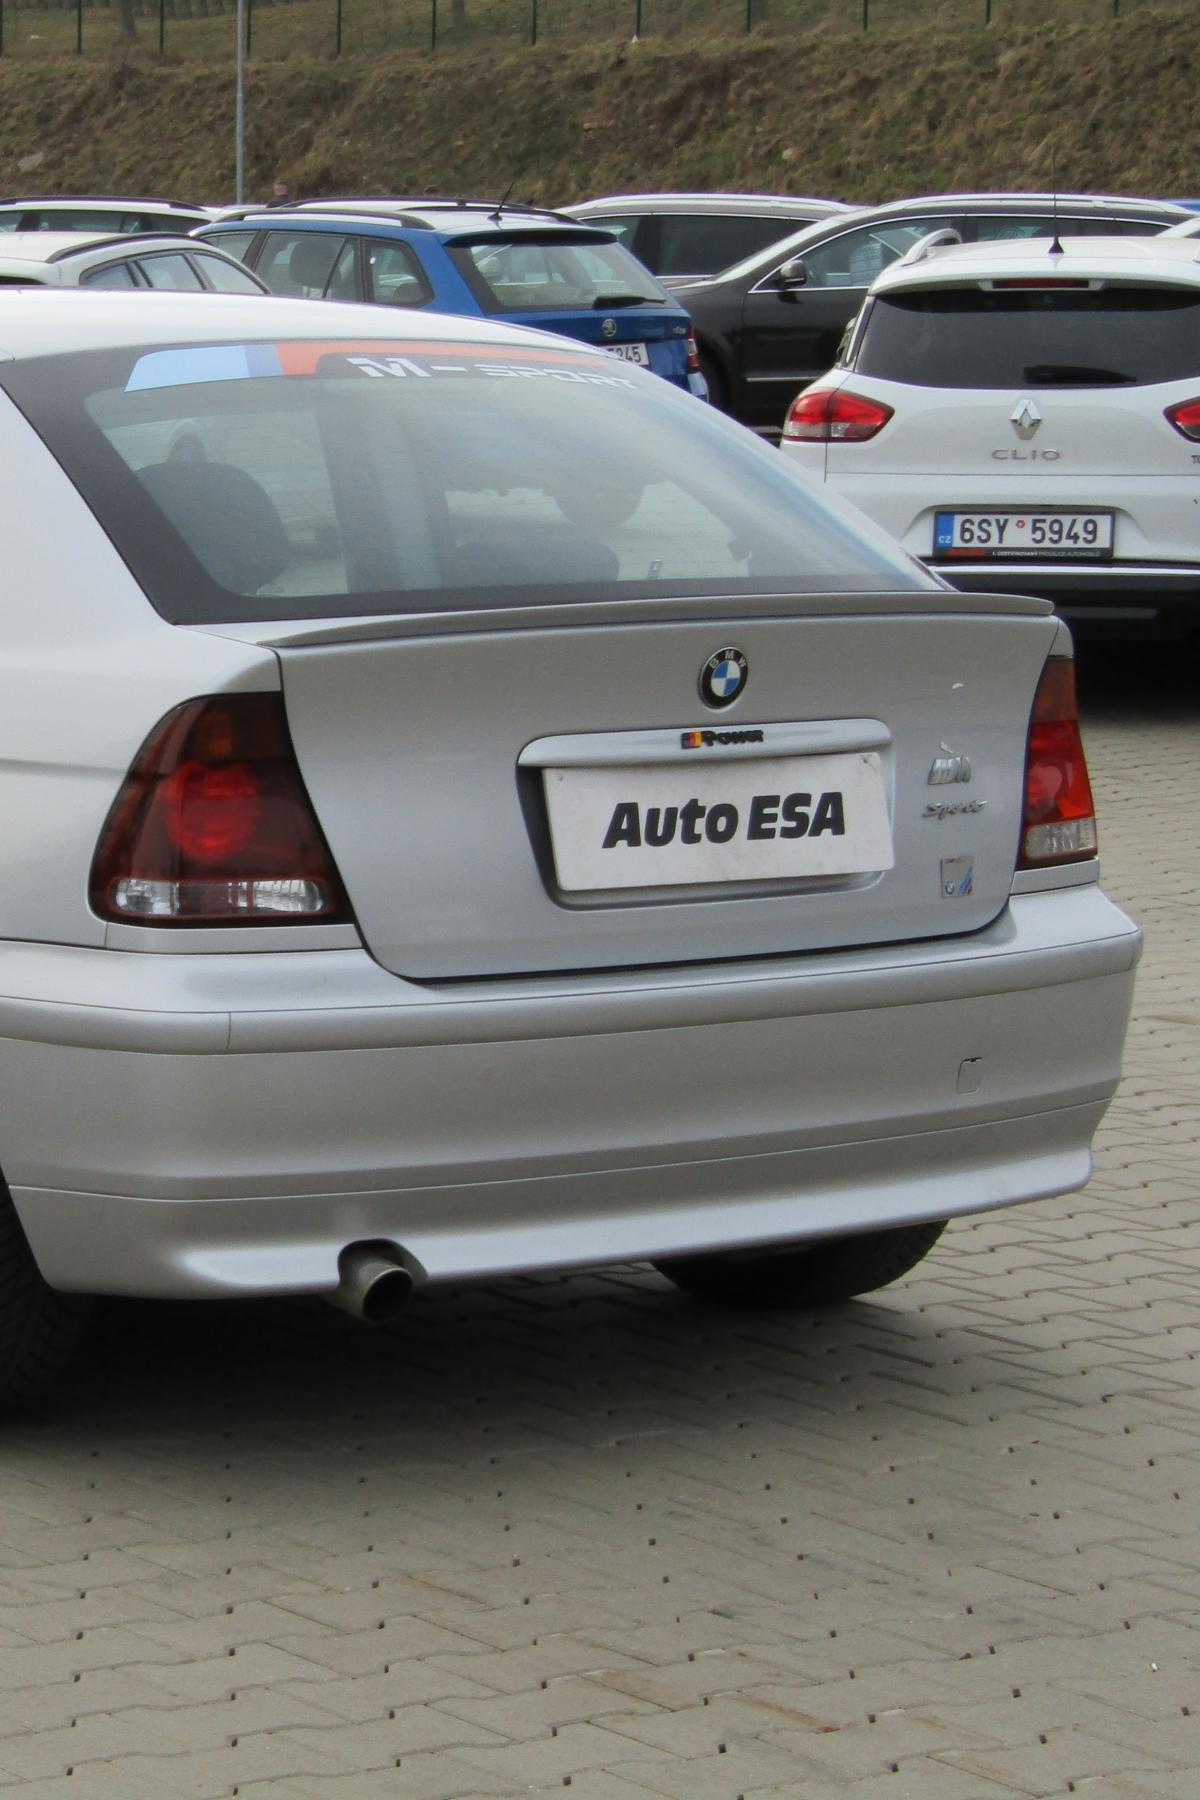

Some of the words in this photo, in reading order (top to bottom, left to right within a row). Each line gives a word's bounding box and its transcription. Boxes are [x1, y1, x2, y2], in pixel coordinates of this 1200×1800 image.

[991, 449, 1061, 461] CLIO
[938, 535, 952, 544] CZ
[960, 518, 1009, 544] 6SY
[1031, 518, 1098, 545] 5949
[709, 650, 747, 669] BMW
[601, 798, 738, 849] Auto
[747, 791, 846, 841] ESA
